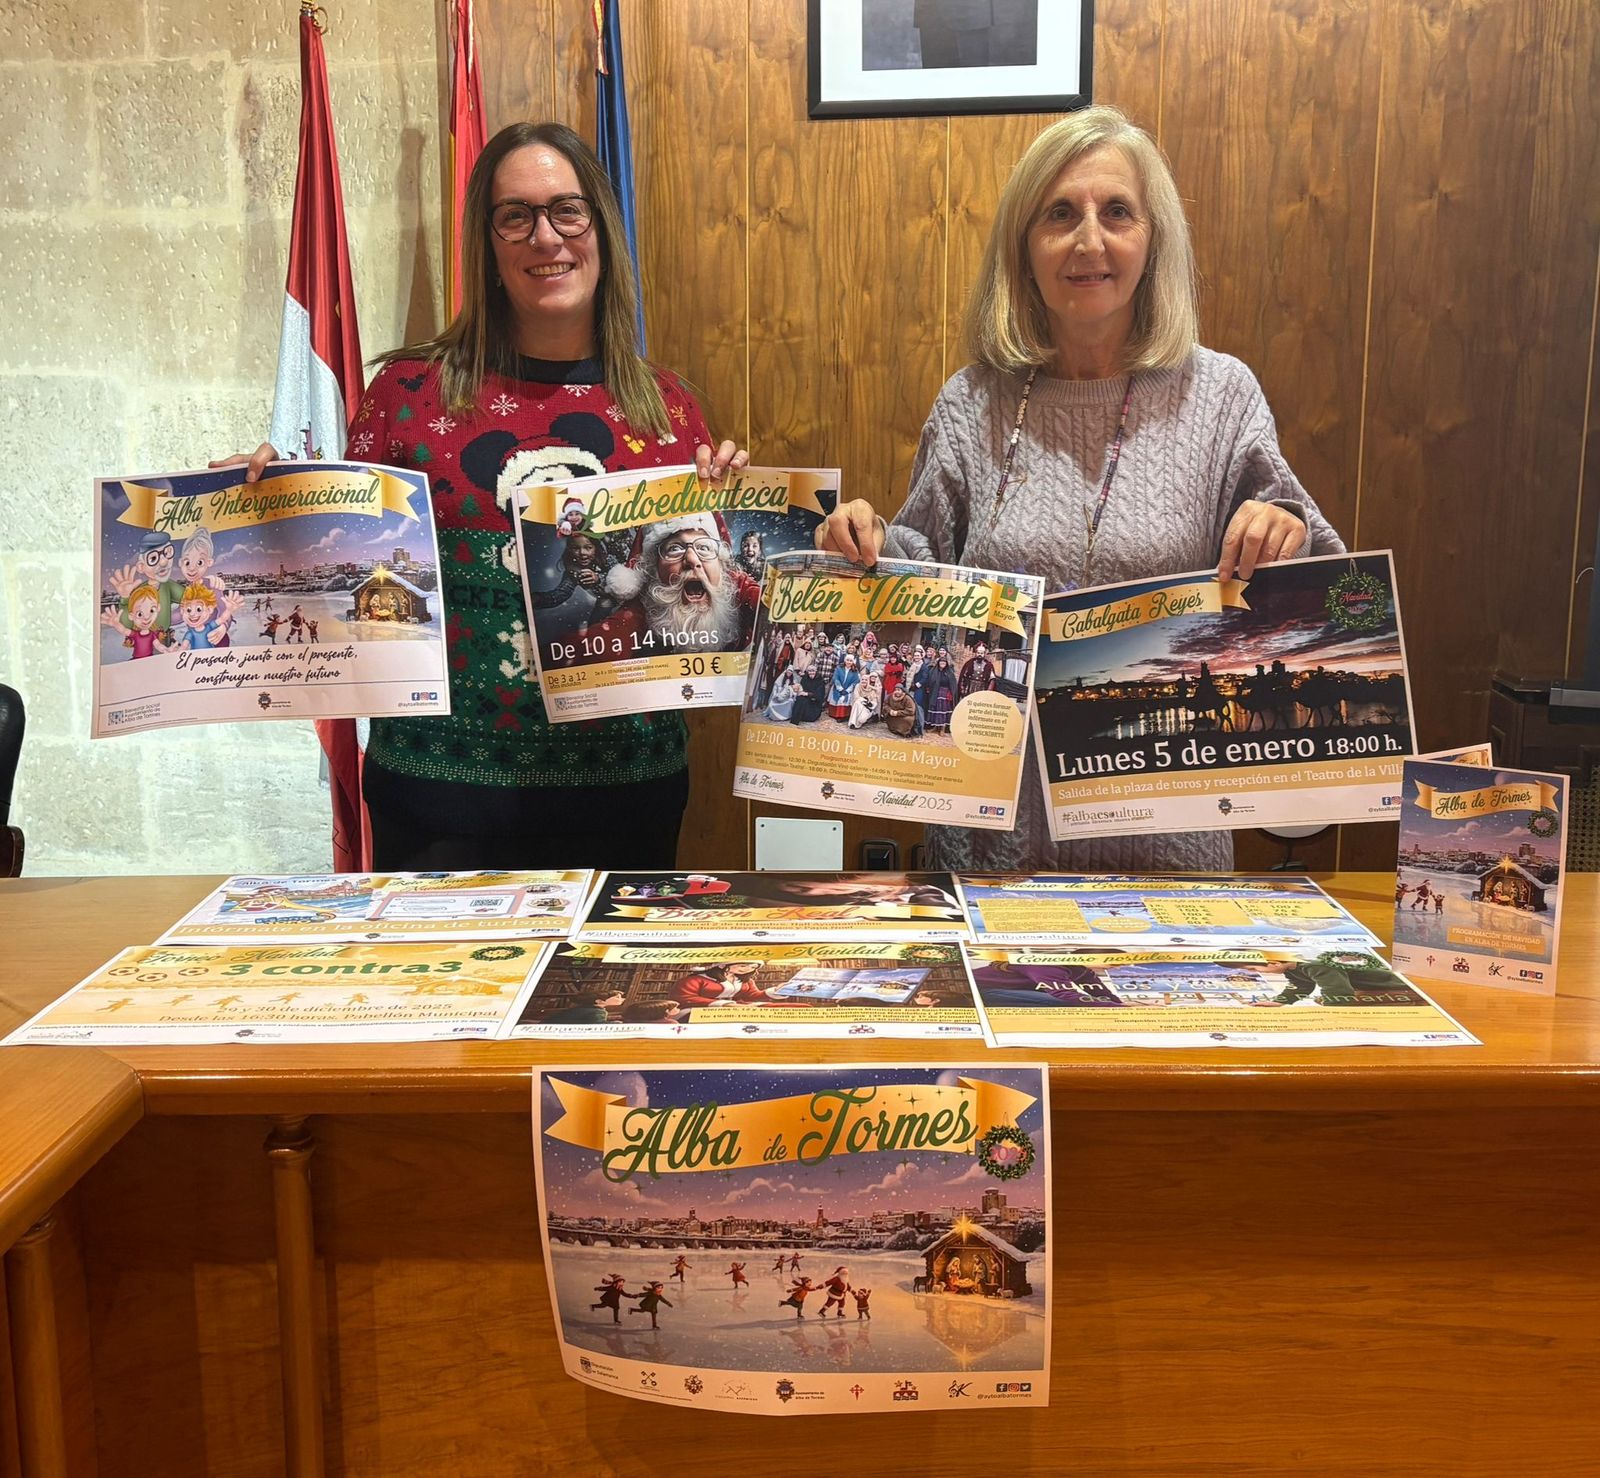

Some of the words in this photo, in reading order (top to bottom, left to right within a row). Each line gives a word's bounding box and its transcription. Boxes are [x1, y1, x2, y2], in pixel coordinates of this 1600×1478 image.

[154, 496, 203, 531] Alba
[210, 477, 380, 520] Intergeneracional
[579, 472, 788, 538] Ludoeducateca
[772, 572, 843, 620] Belén
[858, 572, 990, 621] Viviente
[996, 600, 1015, 612] Plaza
[993, 610, 1016, 622] Mayor
[1062, 604, 1142, 639] Cabalgata
[1148, 591, 1204, 618] Reyes
[550, 642, 575, 661] De
[581, 636, 605, 657] 10
[612, 641, 622, 652] a
[630, 631, 656, 650] 14
[662, 628, 719, 647] horas
[176, 652, 192, 670] El
[190, 650, 239, 671] pasado,
[239, 648, 272, 668] junto
[276, 652, 294, 661] con
[298, 647, 309, 660] el
[308, 645, 358, 665] presente,
[678, 658, 705, 676] 30
[710, 656, 722, 674] €
[195, 669, 260, 688] construyen
[264, 666, 303, 682] nuestro
[305, 666, 341, 682] futuro
[548, 676, 559, 685] De
[560, 674, 566, 682] 3
[576, 672, 587, 681] 12
[746, 729, 755, 742] De
[755, 730, 784, 746] 12:00
[786, 736, 794, 748] a
[798, 734, 840, 752] 18:00
[868, 744, 906, 762] Plaza
[912, 750, 960, 769] Mayor
[1057, 753, 1146, 778] Lunes
[1154, 740, 1172, 766] 5
[1181, 738, 1218, 764] de
[1225, 738, 1314, 762] enero
[1324, 736, 1379, 756] 18:00
[1384, 734, 1404, 751] h.
[1058, 788, 1092, 800] Salida
[1095, 784, 1109, 796] de
[1110, 784, 1122, 795] la
[1124, 782, 1153, 797] plaza
[1156, 779, 1170, 791] de
[1172, 778, 1202, 790] toros
[1204, 779, 1212, 790] y
[1214, 773, 1272, 790] recepción
[1274, 774, 1288, 783] en
[1290, 770, 1301, 782] el
[1304, 768, 1344, 781] Teatro
[1346, 766, 1362, 778] de
[1364, 765, 1376, 776] la
[872, 790, 916, 808] Navidad
[916, 796, 954, 811] 2025
[1435, 795, 1467, 816] Alba
[1471, 792, 1486, 808] de
[1490, 790, 1532, 807] Tormes
[1091, 880, 1186, 890] Escaparates
[645, 907, 753, 920] Buzón
[764, 906, 860, 920] Real
[180, 924, 293, 933] Infórmate
[477, 920, 565, 928] turismo
[1452, 927, 1501, 940] PROGRAMACIÓN
[1512, 935, 1540, 945] NAVIDAD
[137, 950, 221, 964] Torneo
[231, 945, 351, 961] Navidad
[620, 948, 774, 960] Cuentacuentos
[784, 945, 890, 956] Navidad
[1500, 940, 1527, 950] TORMES
[1016, 954, 1096, 963] Concurso
[1105, 954, 1173, 964] postales
[1182, 952, 1266, 962] navideñas
[220, 964, 256, 976] 3
[1035, 981, 1152, 990] Alumnos
[1079, 994, 1111, 1003] de
[1295, 992, 1410, 1002] Primaria
[343, 1012, 414, 1020] Pabellón
[418, 1010, 498, 1018] Municipal
[601, 1100, 742, 1184] Alba
[762, 1134, 789, 1162] de
[797, 1085, 979, 1167] Tormes
